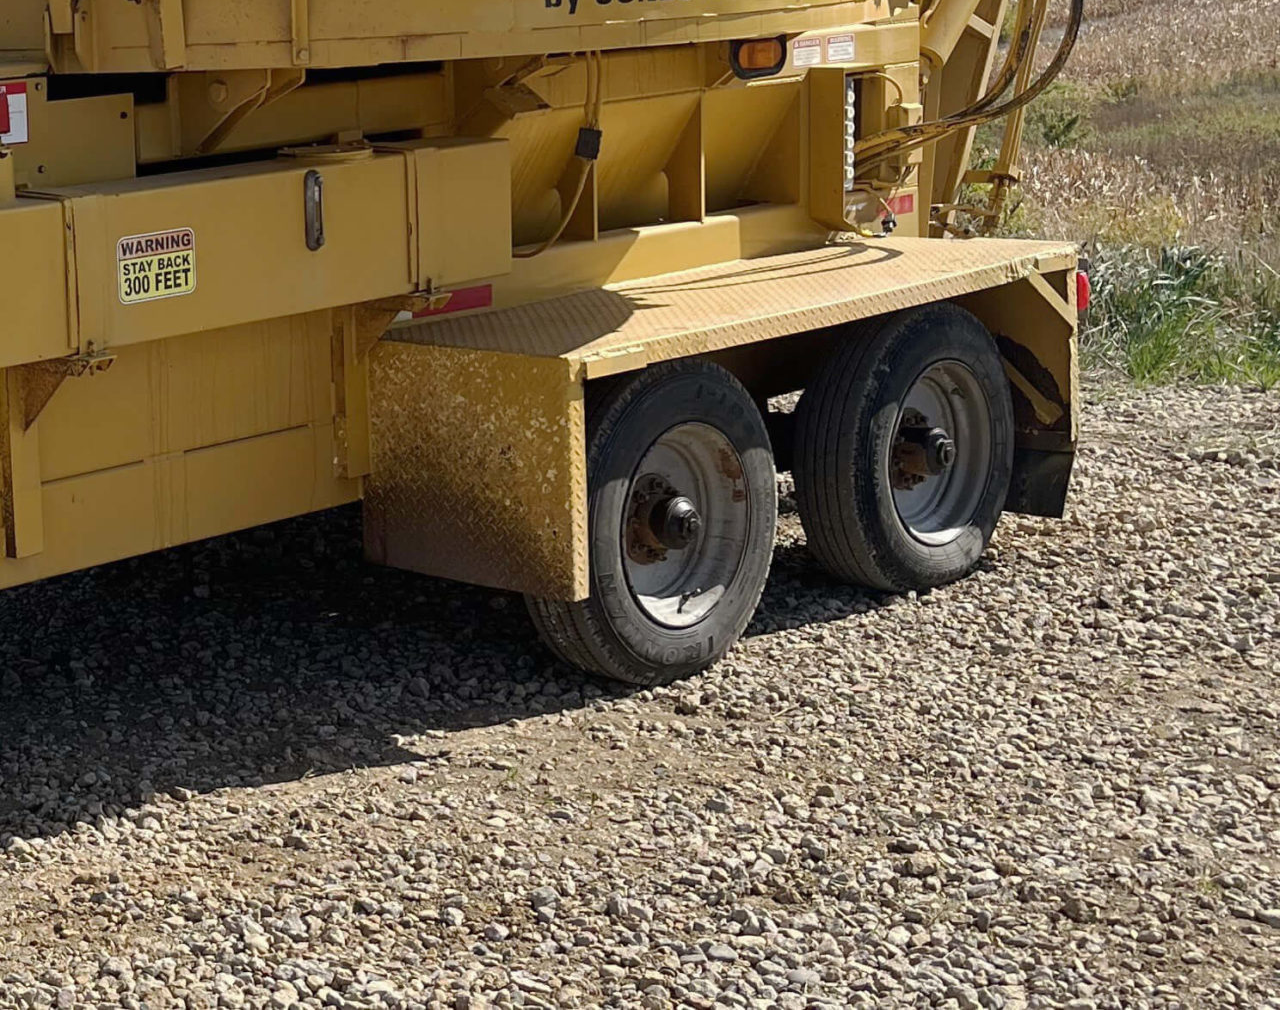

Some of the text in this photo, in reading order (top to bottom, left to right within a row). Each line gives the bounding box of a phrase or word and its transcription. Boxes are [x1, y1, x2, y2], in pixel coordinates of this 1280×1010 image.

[121, 233, 191, 257] WARNING
[123, 253, 191, 276] STAY BACK
[124, 268, 191, 296] 300 FEET
